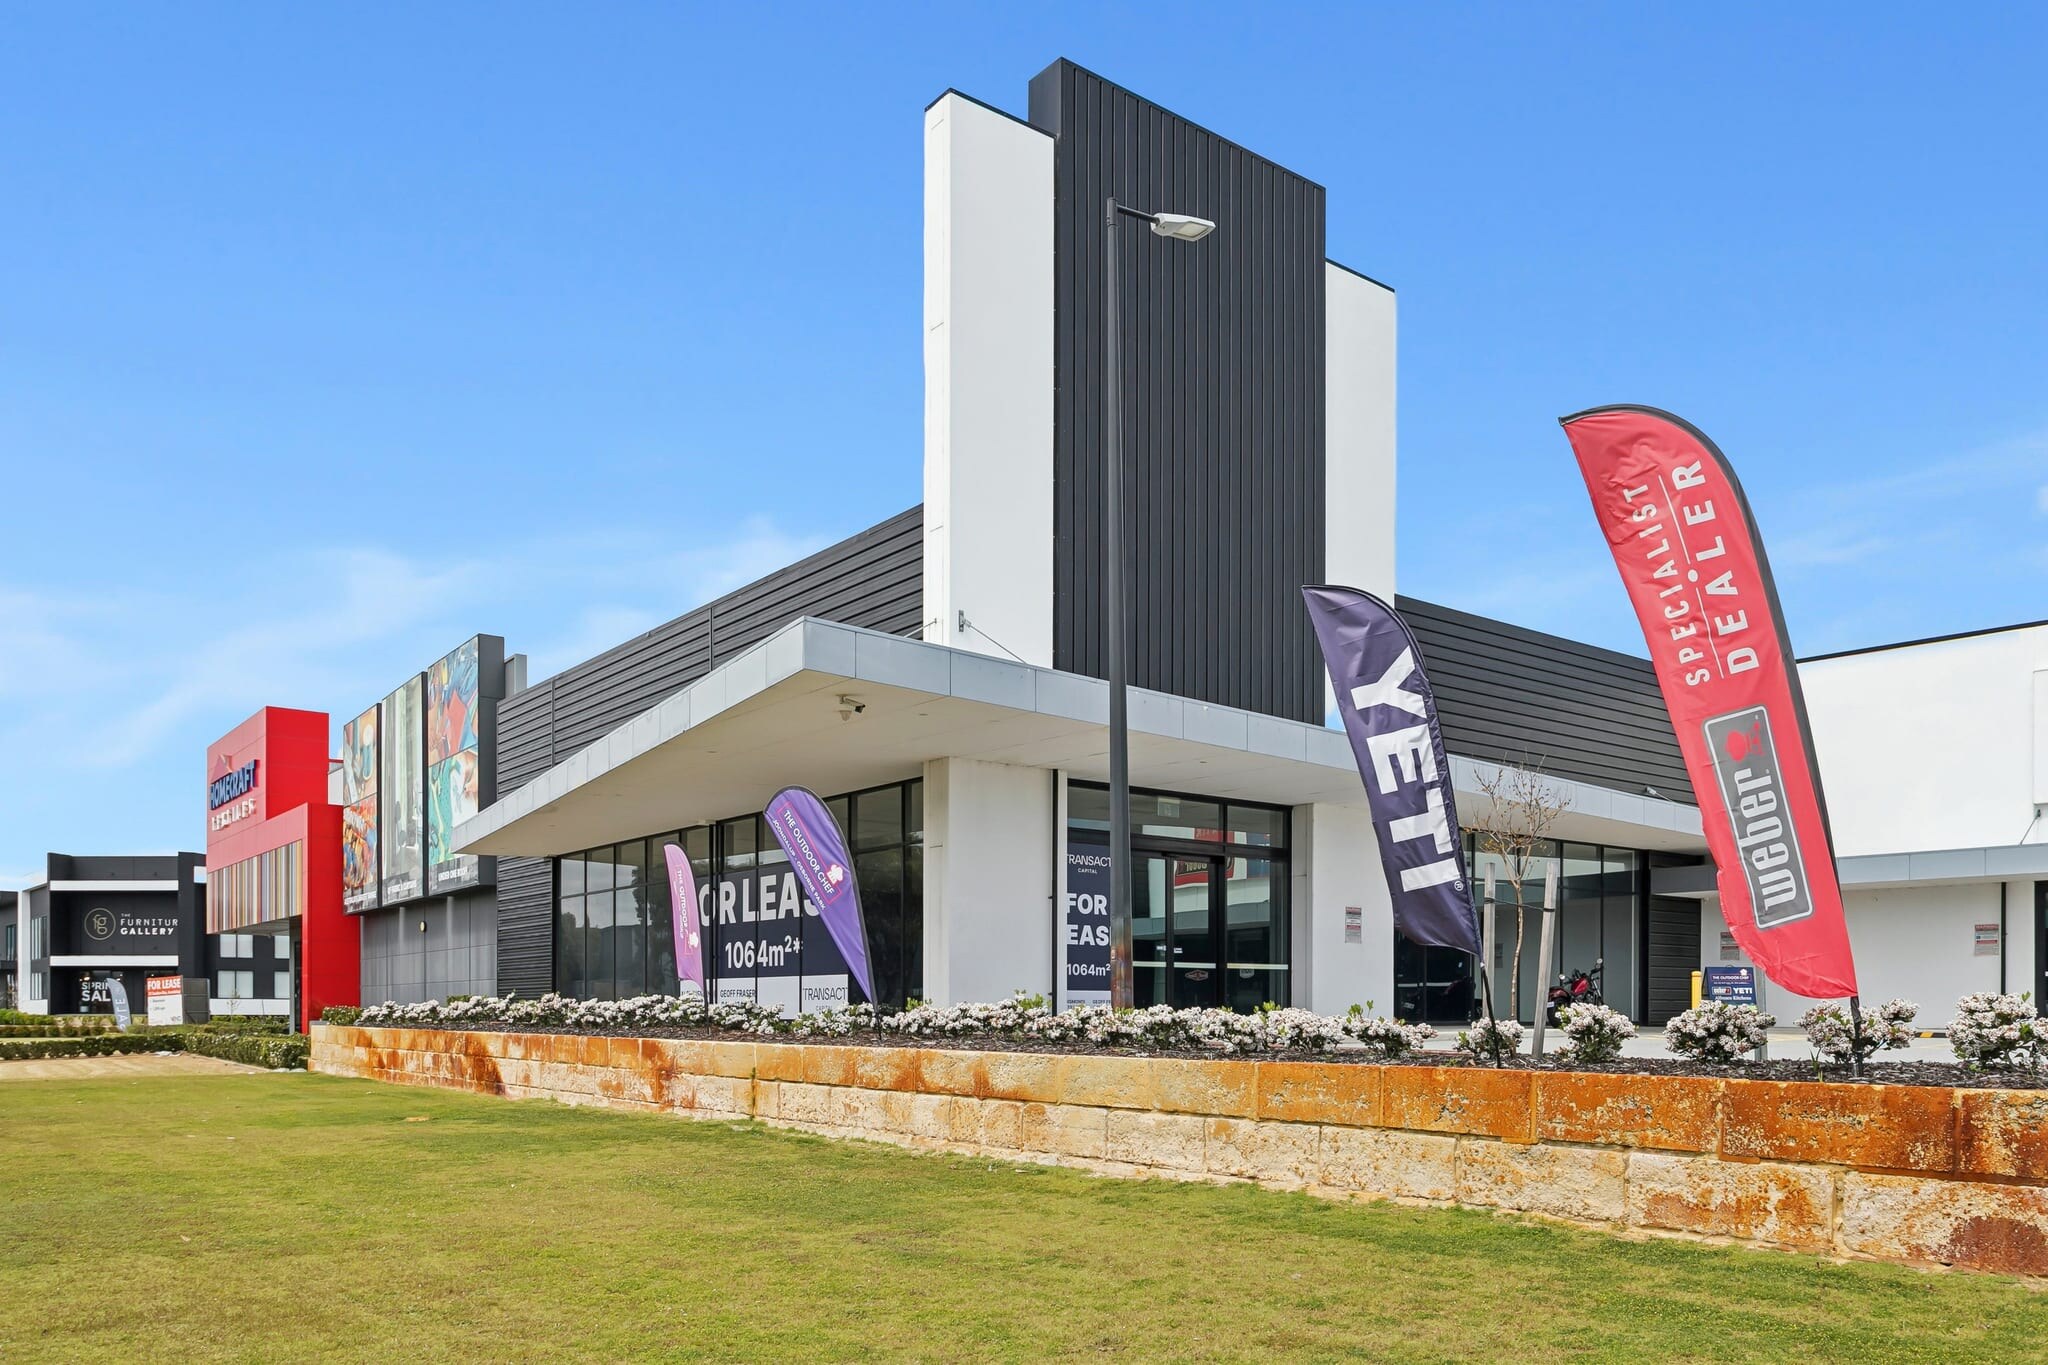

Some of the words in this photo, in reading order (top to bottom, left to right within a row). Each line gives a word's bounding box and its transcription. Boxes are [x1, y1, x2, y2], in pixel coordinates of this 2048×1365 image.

[1672, 460, 1760, 675] DEALER
[1623, 484, 1710, 686] SPECIALIST
[210, 760, 257, 810] HOMECRAFT
[1351, 645, 1461, 892] YETI
[784, 809, 796, 828] THE
[793, 828, 820, 873] OUTDOOR
[817, 871, 835, 894] CHEF
[1735, 767, 1797, 911] weber
[773, 819, 796, 857] JOONDALUP
[796, 861, 817, 893] OSBORNE
[814, 891, 826, 910] PARK
[698, 881, 736, 926] OR
[1067, 893, 1108, 915] FOR
[120, 918, 179, 926] FURNITUR
[120, 927, 174, 935] GALLERY
[1067, 924, 1111, 946] EAS
[81, 990, 111, 1002] SAL
[148, 980, 161, 990] FOR
[162, 979, 181, 989] LEASE
[720, 989, 736, 998] GEOFF
[803, 987, 848, 1001] TRANSACT
